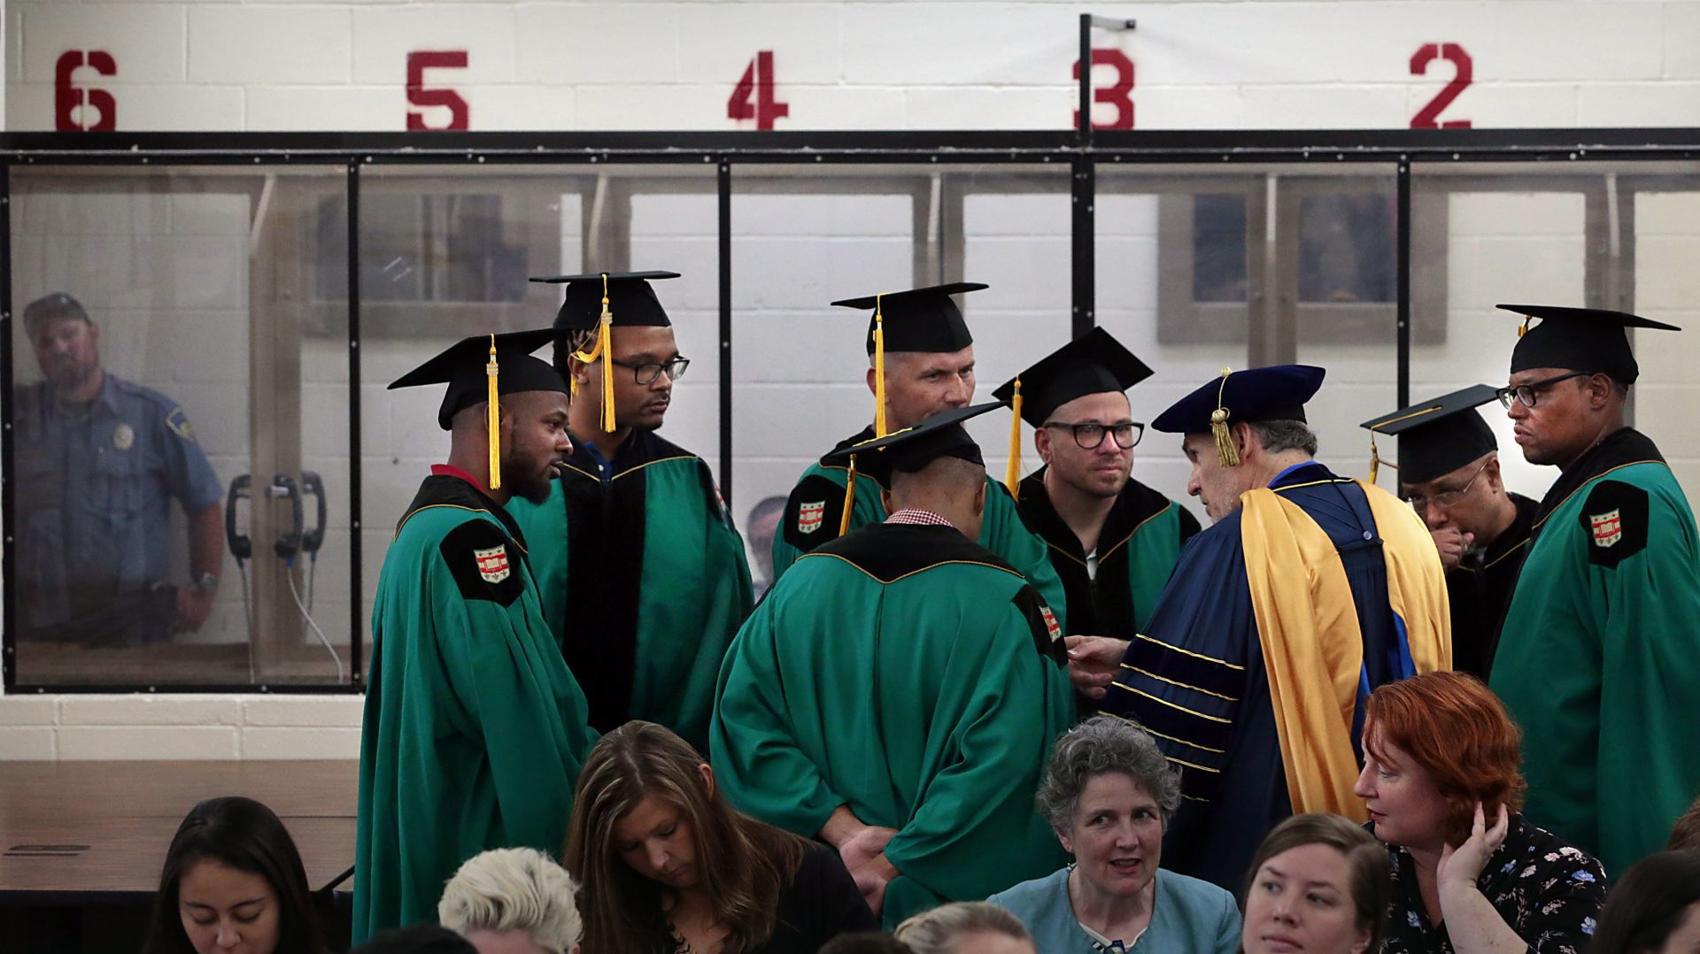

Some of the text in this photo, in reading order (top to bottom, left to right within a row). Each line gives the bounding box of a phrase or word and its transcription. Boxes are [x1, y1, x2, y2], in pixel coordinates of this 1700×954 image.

[56, 50, 117, 131] 6
[406, 50, 470, 131] 5
[727, 50, 789, 131] 4
[1072, 48, 1135, 131] 3
[1409, 43, 1472, 129] 2
